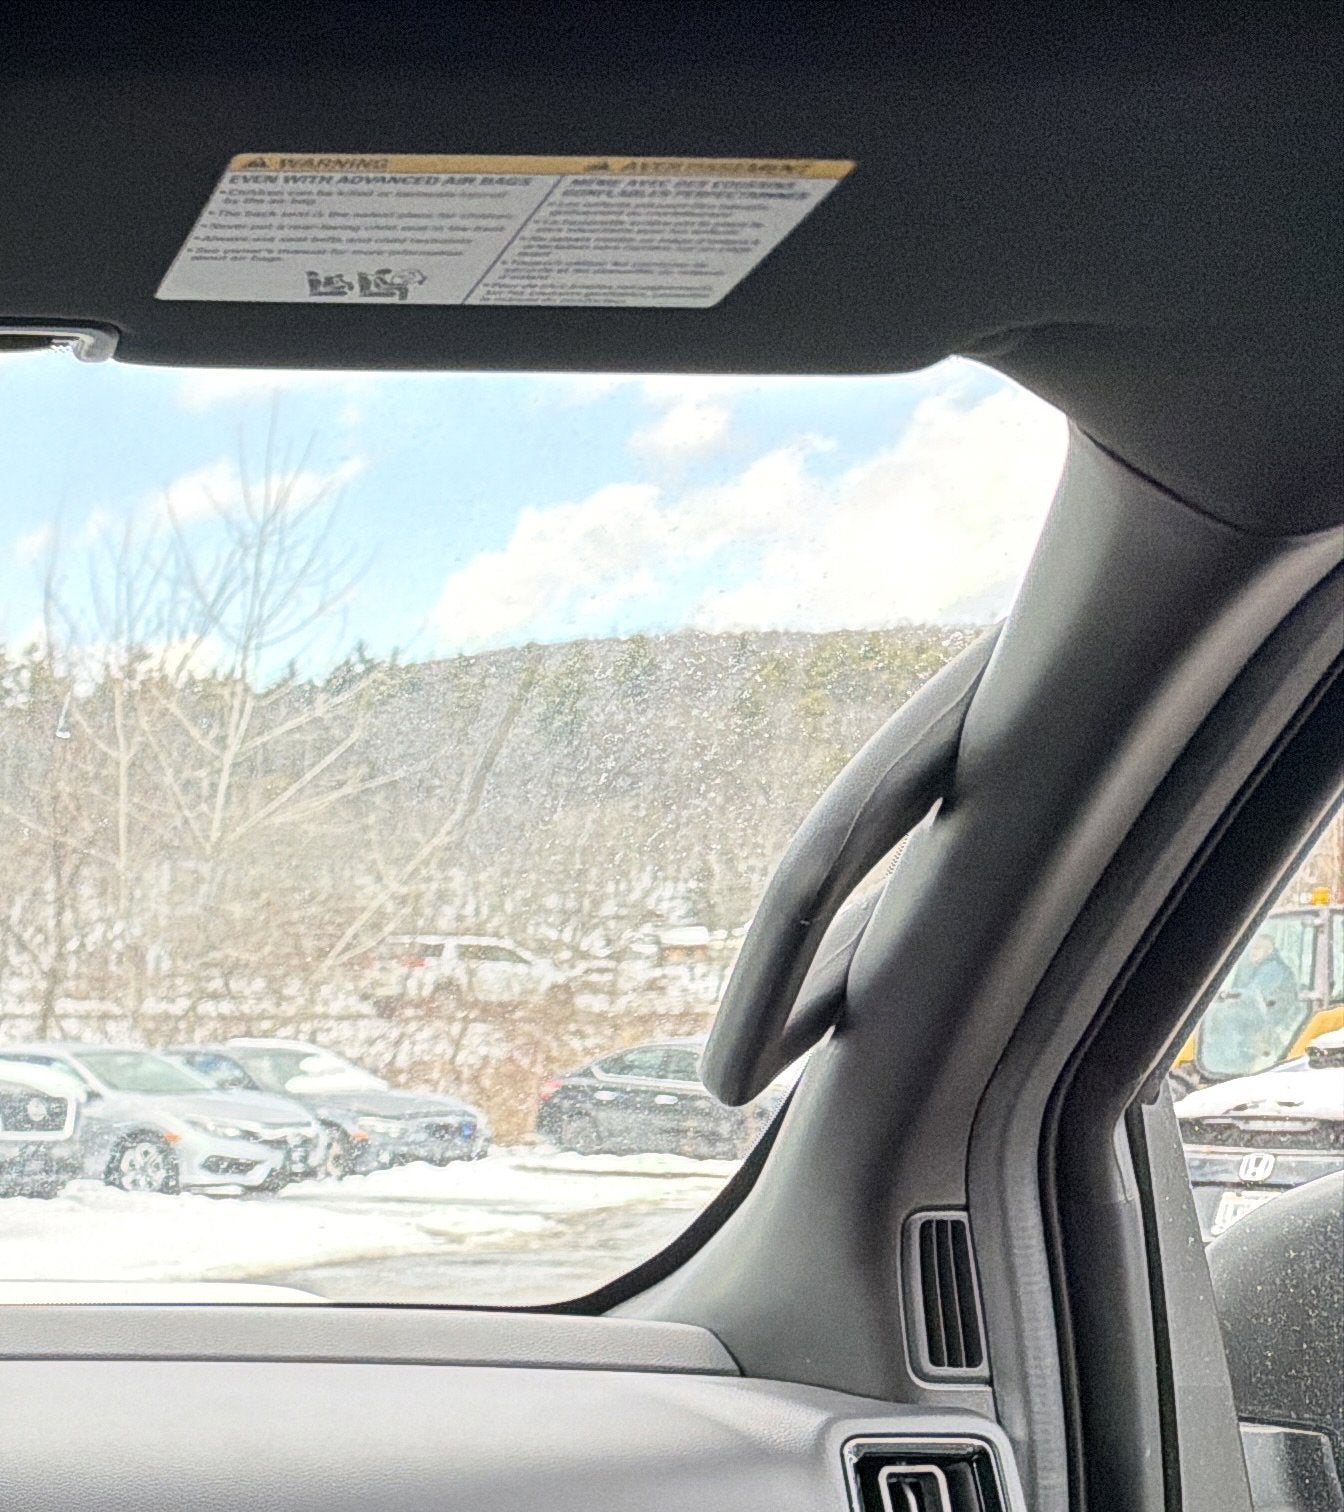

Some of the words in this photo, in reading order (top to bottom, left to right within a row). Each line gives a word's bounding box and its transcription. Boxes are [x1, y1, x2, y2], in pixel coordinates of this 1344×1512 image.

[278, 157, 389, 170] WARNING
[229, 175, 279, 185] EVEN
[283, 175, 334, 185] WITH
[338, 175, 440, 186] ADVANCED
[478, 176, 532, 187] BAGS
